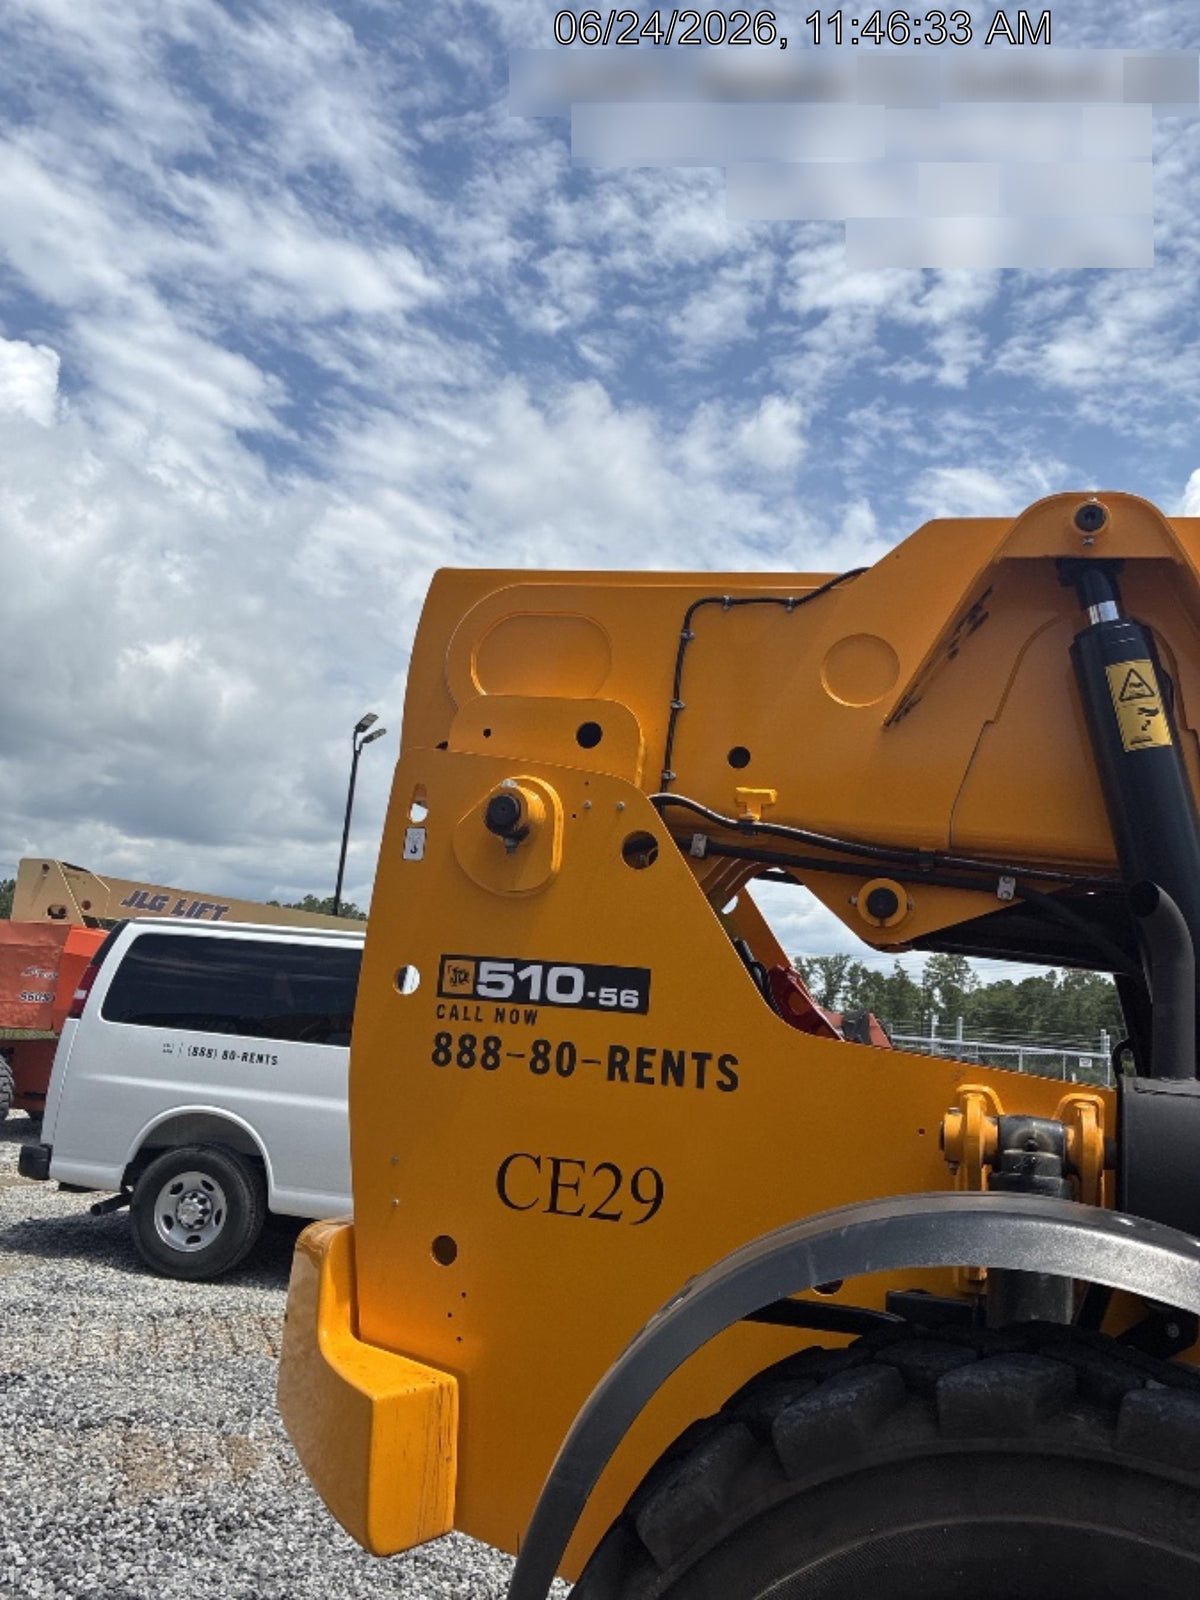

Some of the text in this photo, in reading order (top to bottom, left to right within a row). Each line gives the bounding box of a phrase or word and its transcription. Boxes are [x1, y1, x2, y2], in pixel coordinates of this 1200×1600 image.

[120, 889, 230, 921] JLG LIFT
[436, 1004, 538, 1025] CALL NOW
[221, 1050, 279, 1066] 80-RENTS
[431, 1031, 739, 1092] 888-80-RENTS
[496, 1152, 665, 1225] CE29
